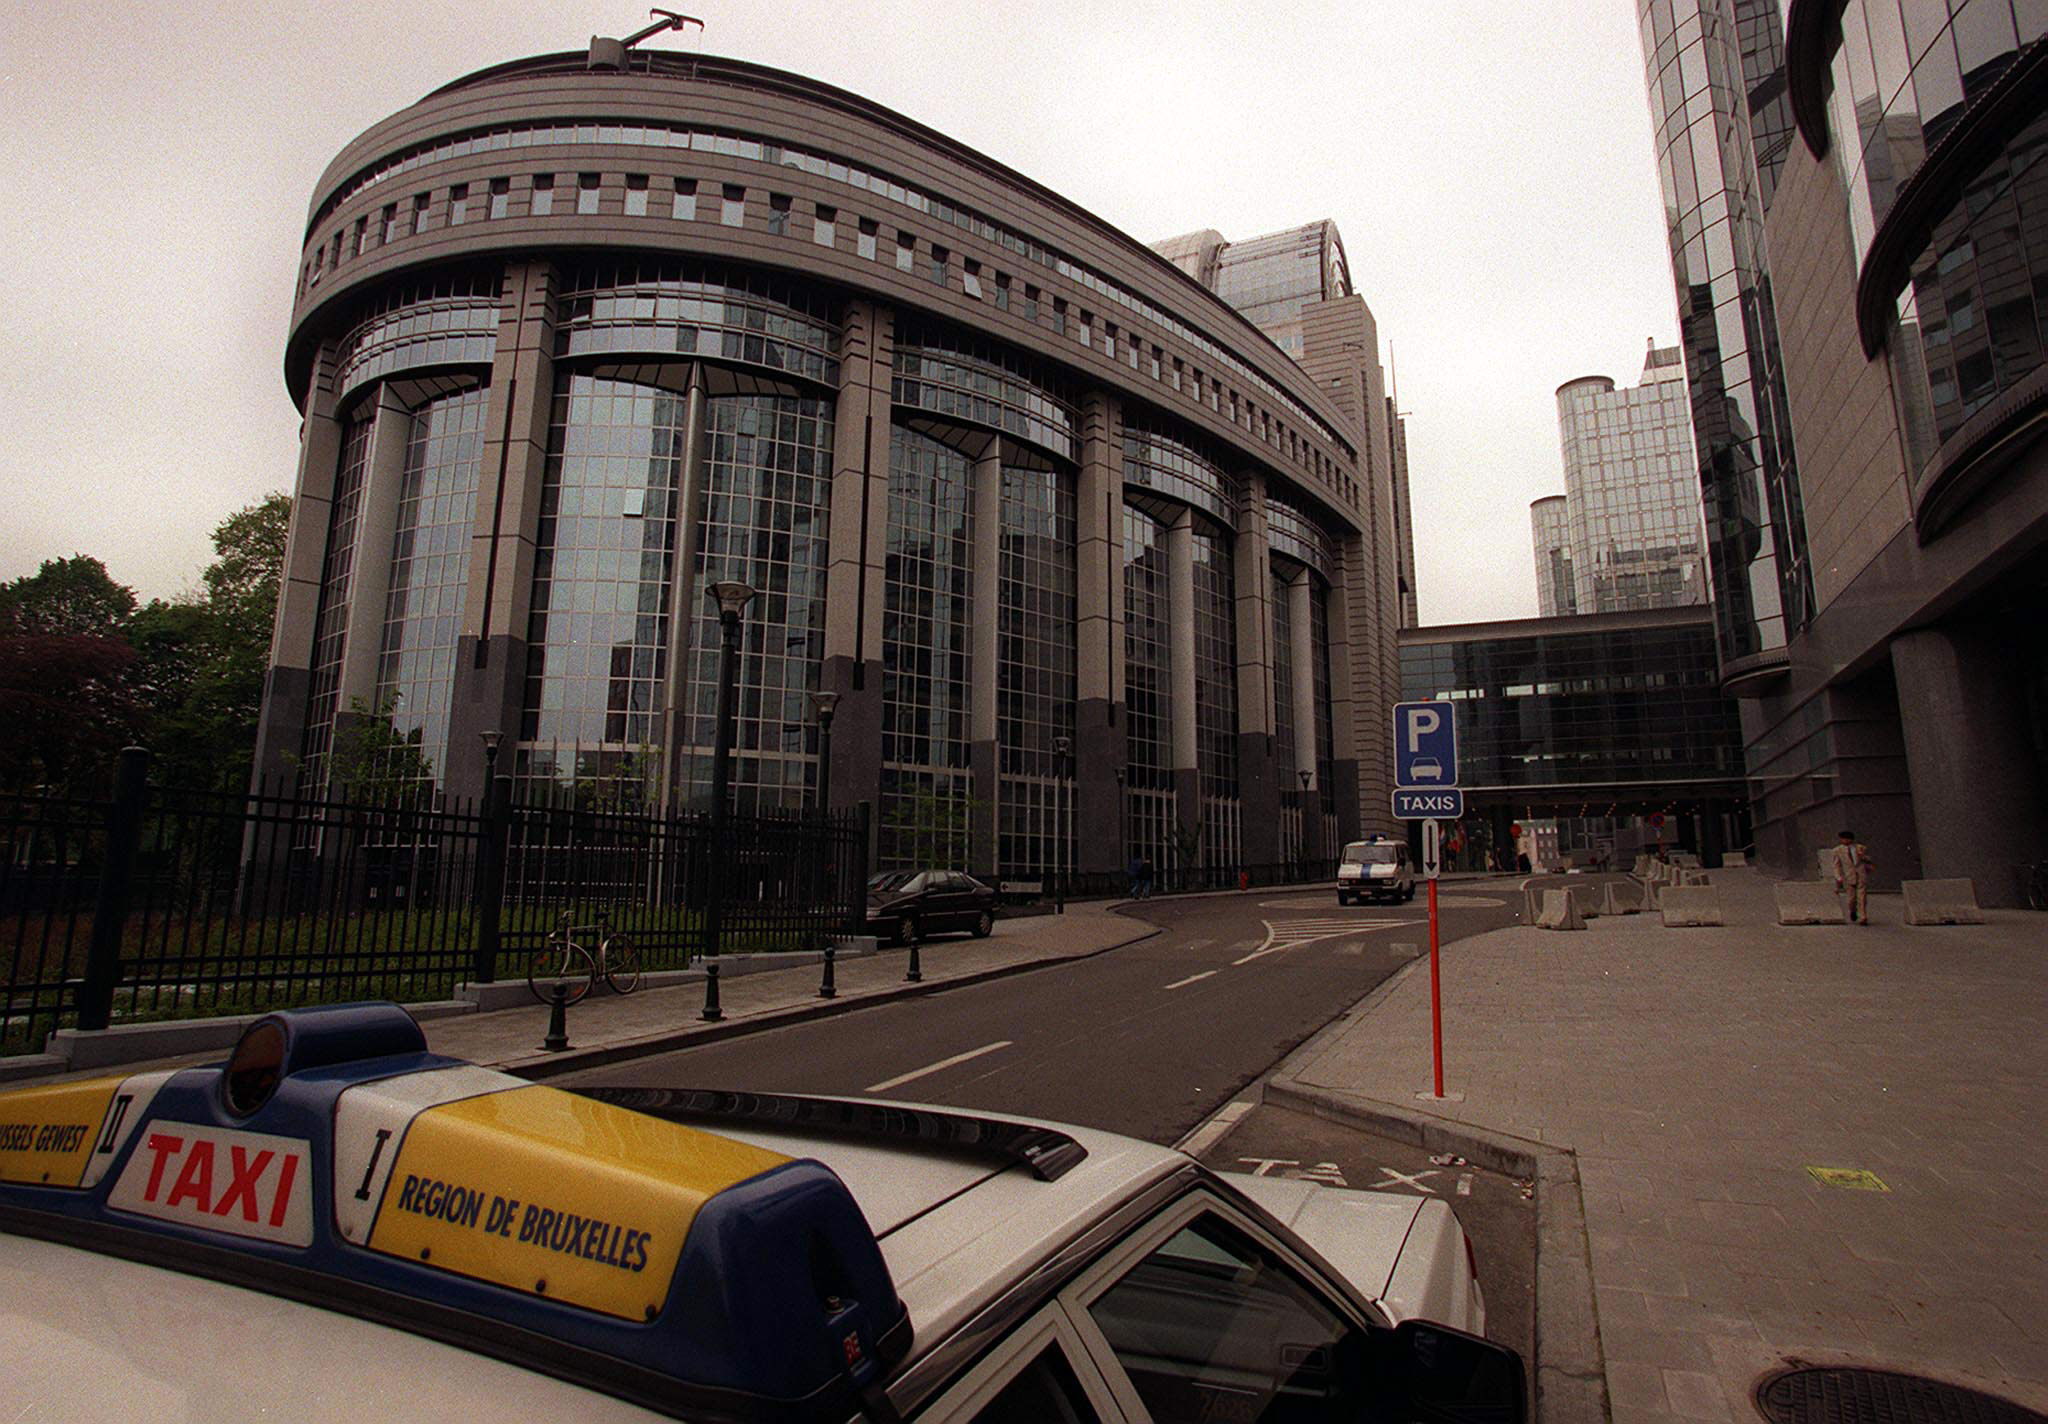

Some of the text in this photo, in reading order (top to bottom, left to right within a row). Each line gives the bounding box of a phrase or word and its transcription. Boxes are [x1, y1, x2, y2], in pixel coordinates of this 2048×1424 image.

[1408, 709, 1440, 752] P
[1400, 796, 1454, 810] TAXIS
[35, 1124, 89, 1152] GEWEST
[144, 1134, 299, 1227] TAXI
[1237, 1157, 1474, 1196] TAXI
[398, 1174, 653, 1273] REGION DE BRUXELLES
